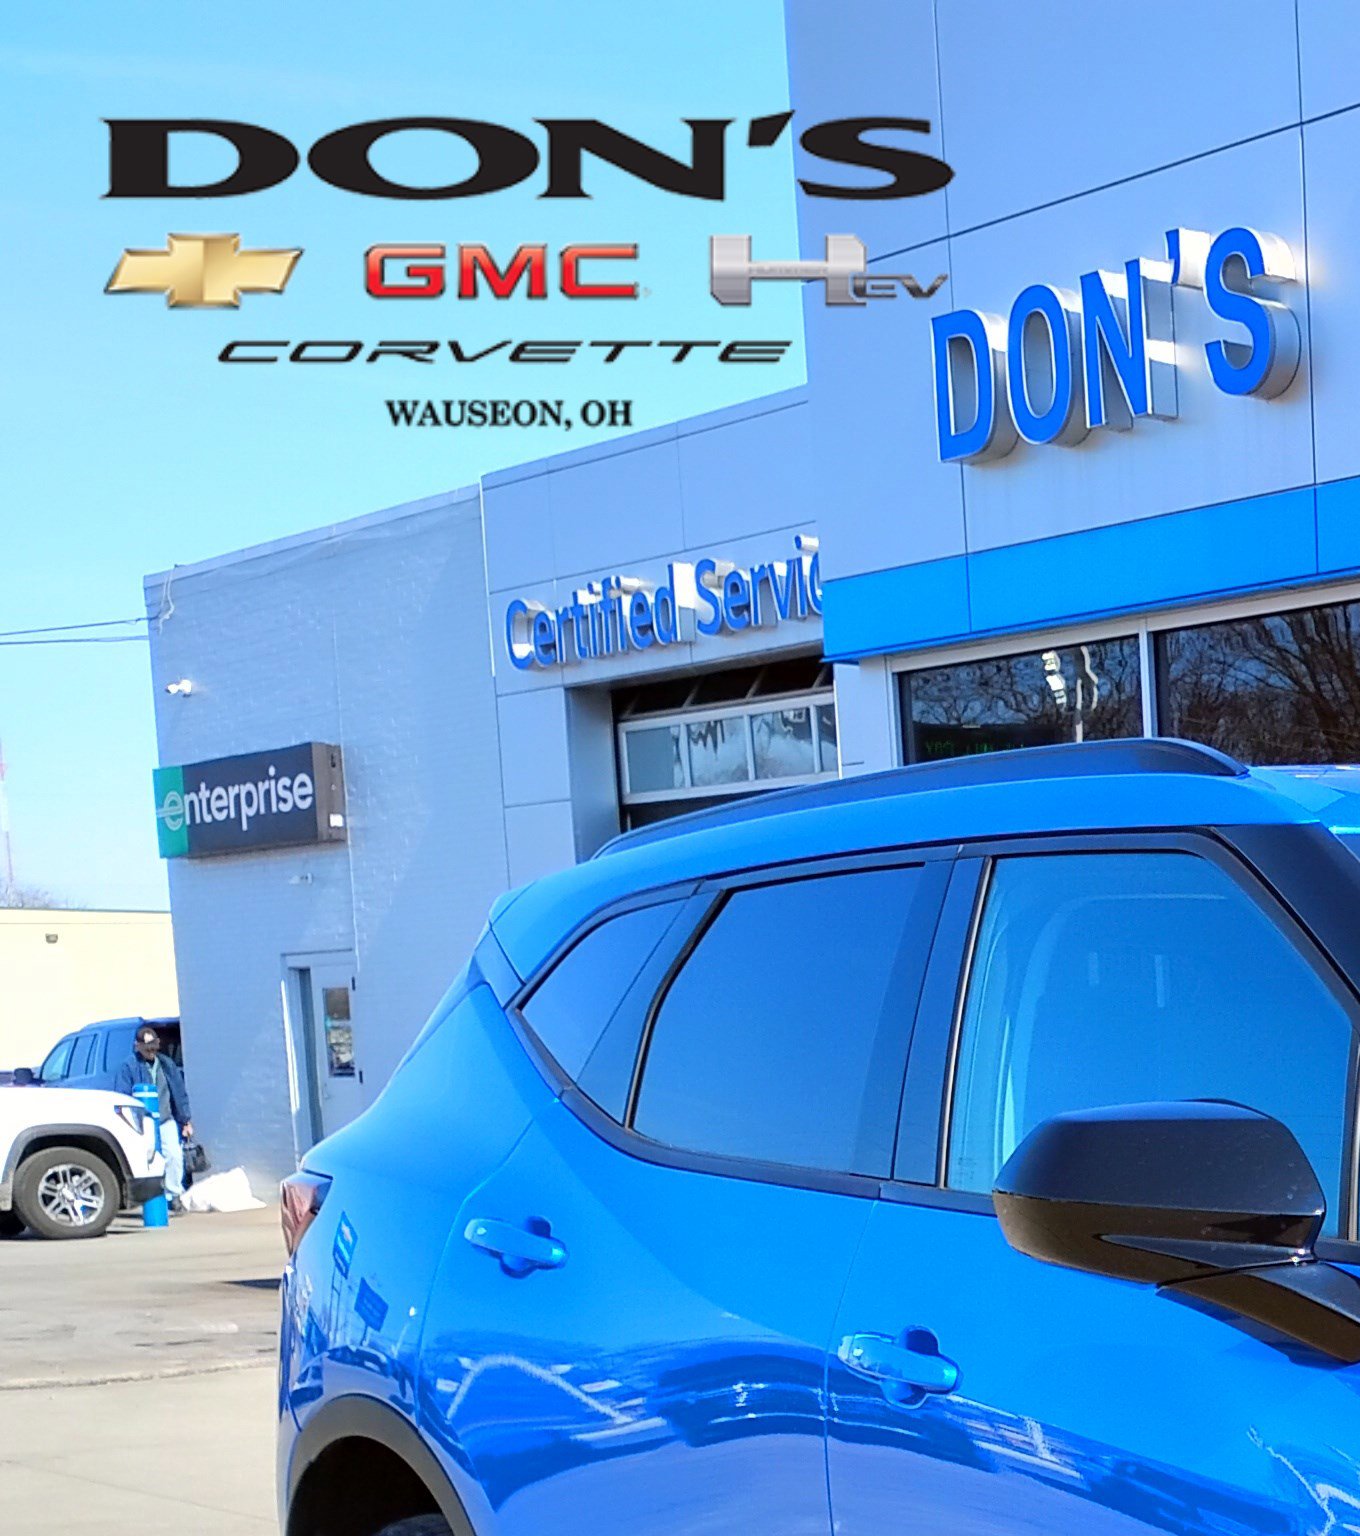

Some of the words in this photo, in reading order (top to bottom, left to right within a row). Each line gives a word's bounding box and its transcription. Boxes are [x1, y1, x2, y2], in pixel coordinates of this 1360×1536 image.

[931, 227, 1290, 463] DON'S
[503, 563, 686, 670] Certified
[157, 765, 314, 832] enterprise
